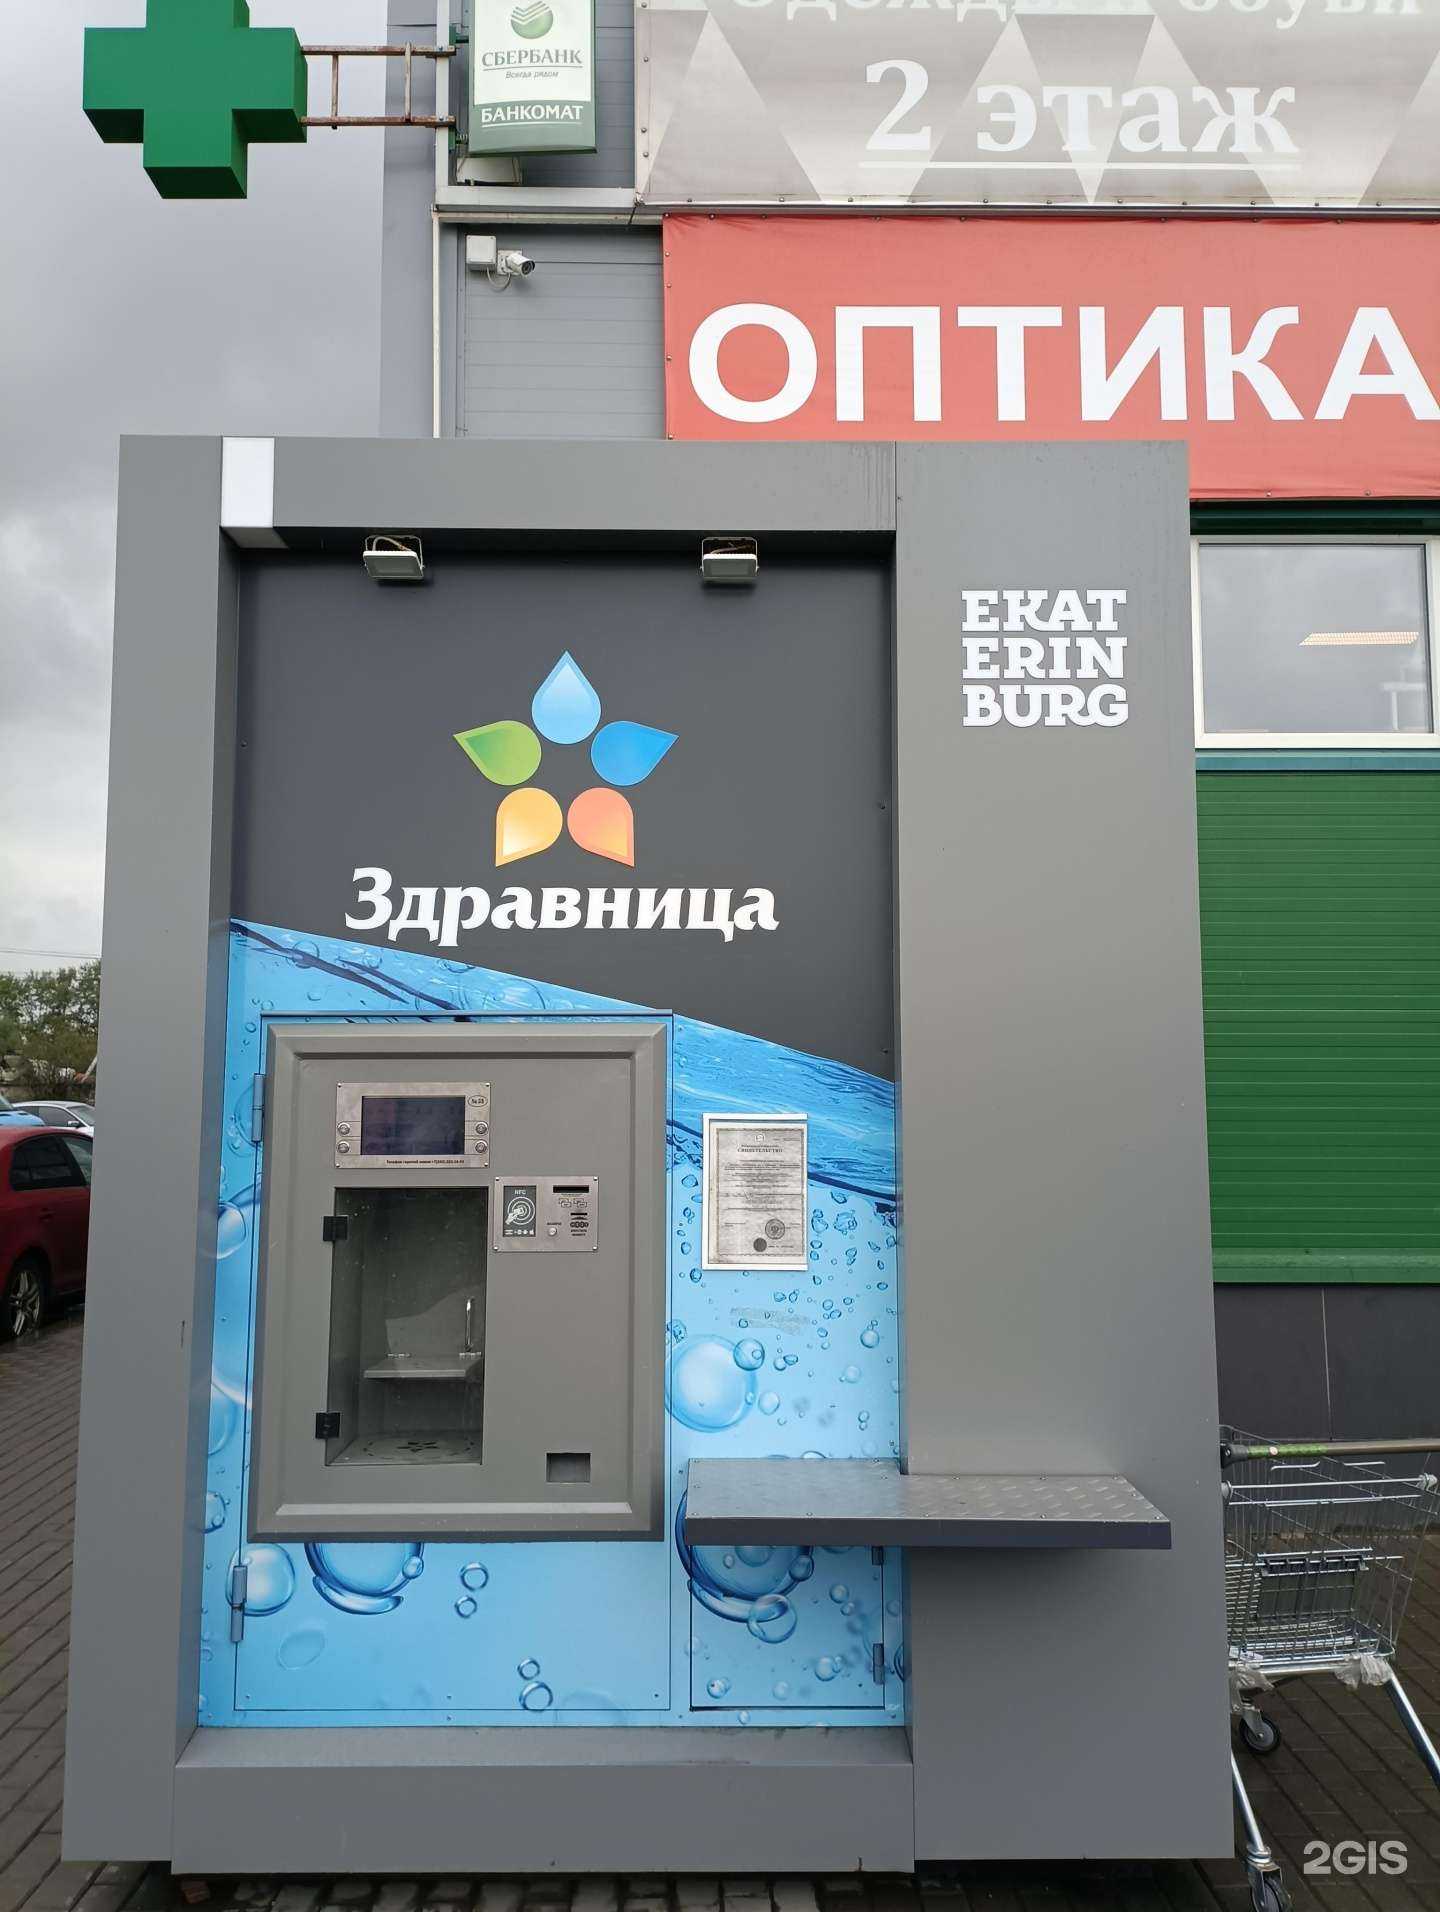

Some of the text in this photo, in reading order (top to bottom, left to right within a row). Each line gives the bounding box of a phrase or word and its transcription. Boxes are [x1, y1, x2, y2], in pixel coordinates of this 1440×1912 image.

[481, 48, 583, 67] СБЕРБАНК
[505, 71, 559, 80] Всегда рядом
[481, 104, 584, 123] БАНКОМАТ
[864, 59, 1299, 154] 2 этаж
[688, 302, 1440, 423] ОПТИКА
[961, 589, 1128, 632] EKAT
[962, 636, 1128, 679] ERIN
[962, 683, 1129, 728] BURG
[344, 867, 780, 947] Здравница
